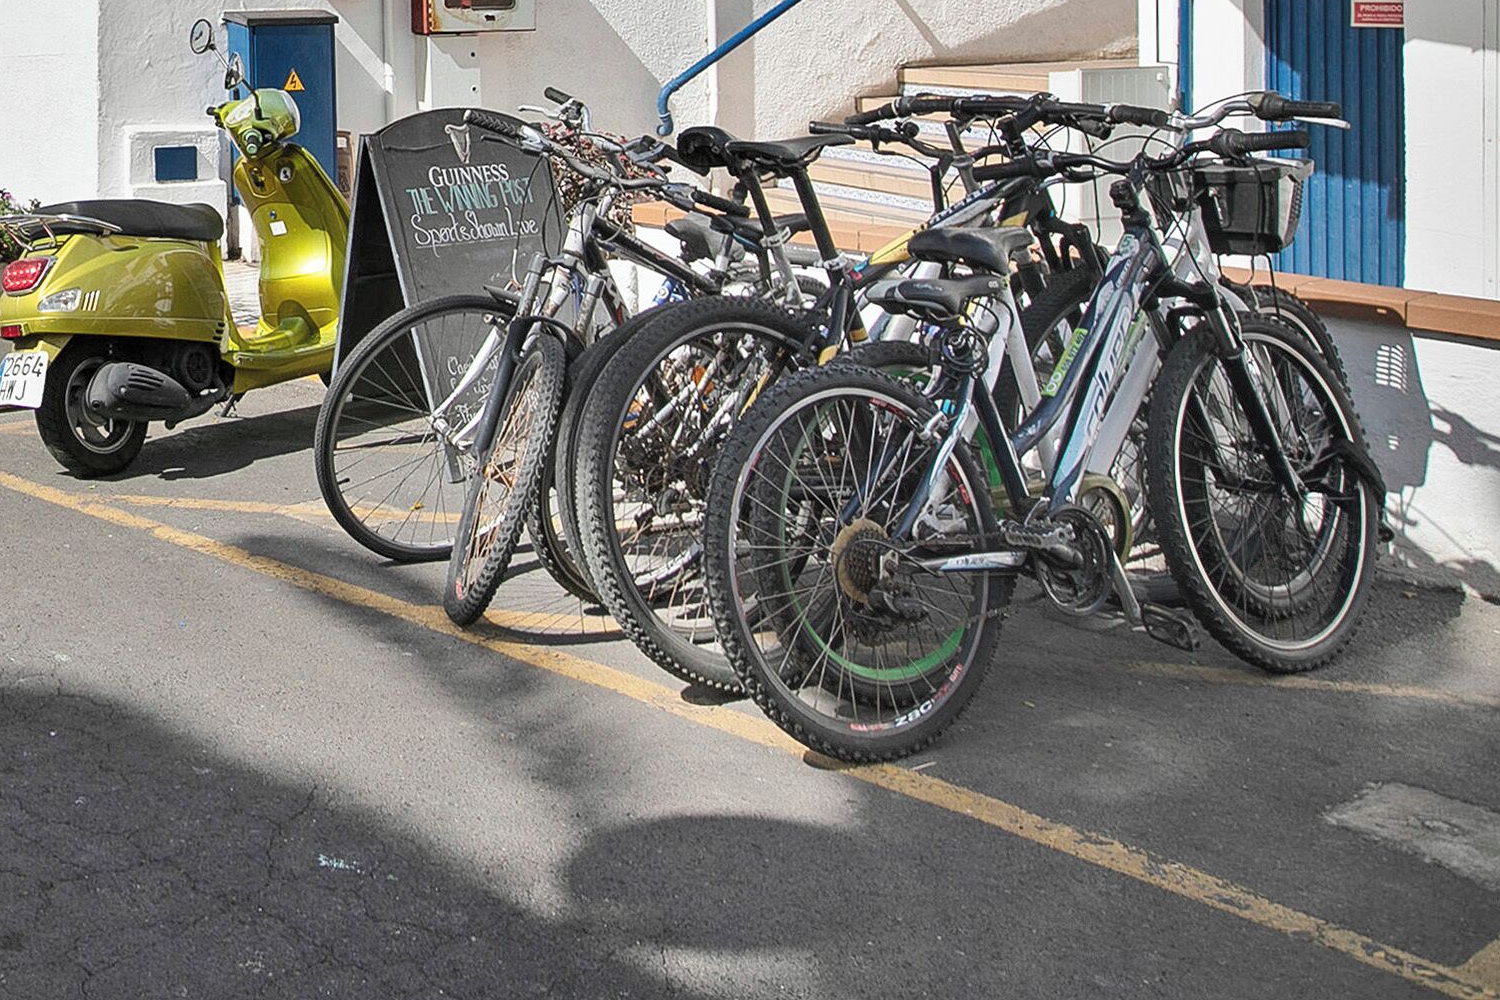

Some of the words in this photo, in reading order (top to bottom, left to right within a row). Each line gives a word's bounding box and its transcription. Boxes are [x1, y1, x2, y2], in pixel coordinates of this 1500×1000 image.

[406, 187, 438, 215] THE
[499, 177, 534, 206] POST
[411, 213, 470, 258] Sports
[465, 210, 510, 240] Shown
[505, 206, 539, 236] Live
[4, 354, 42, 378] 2664
